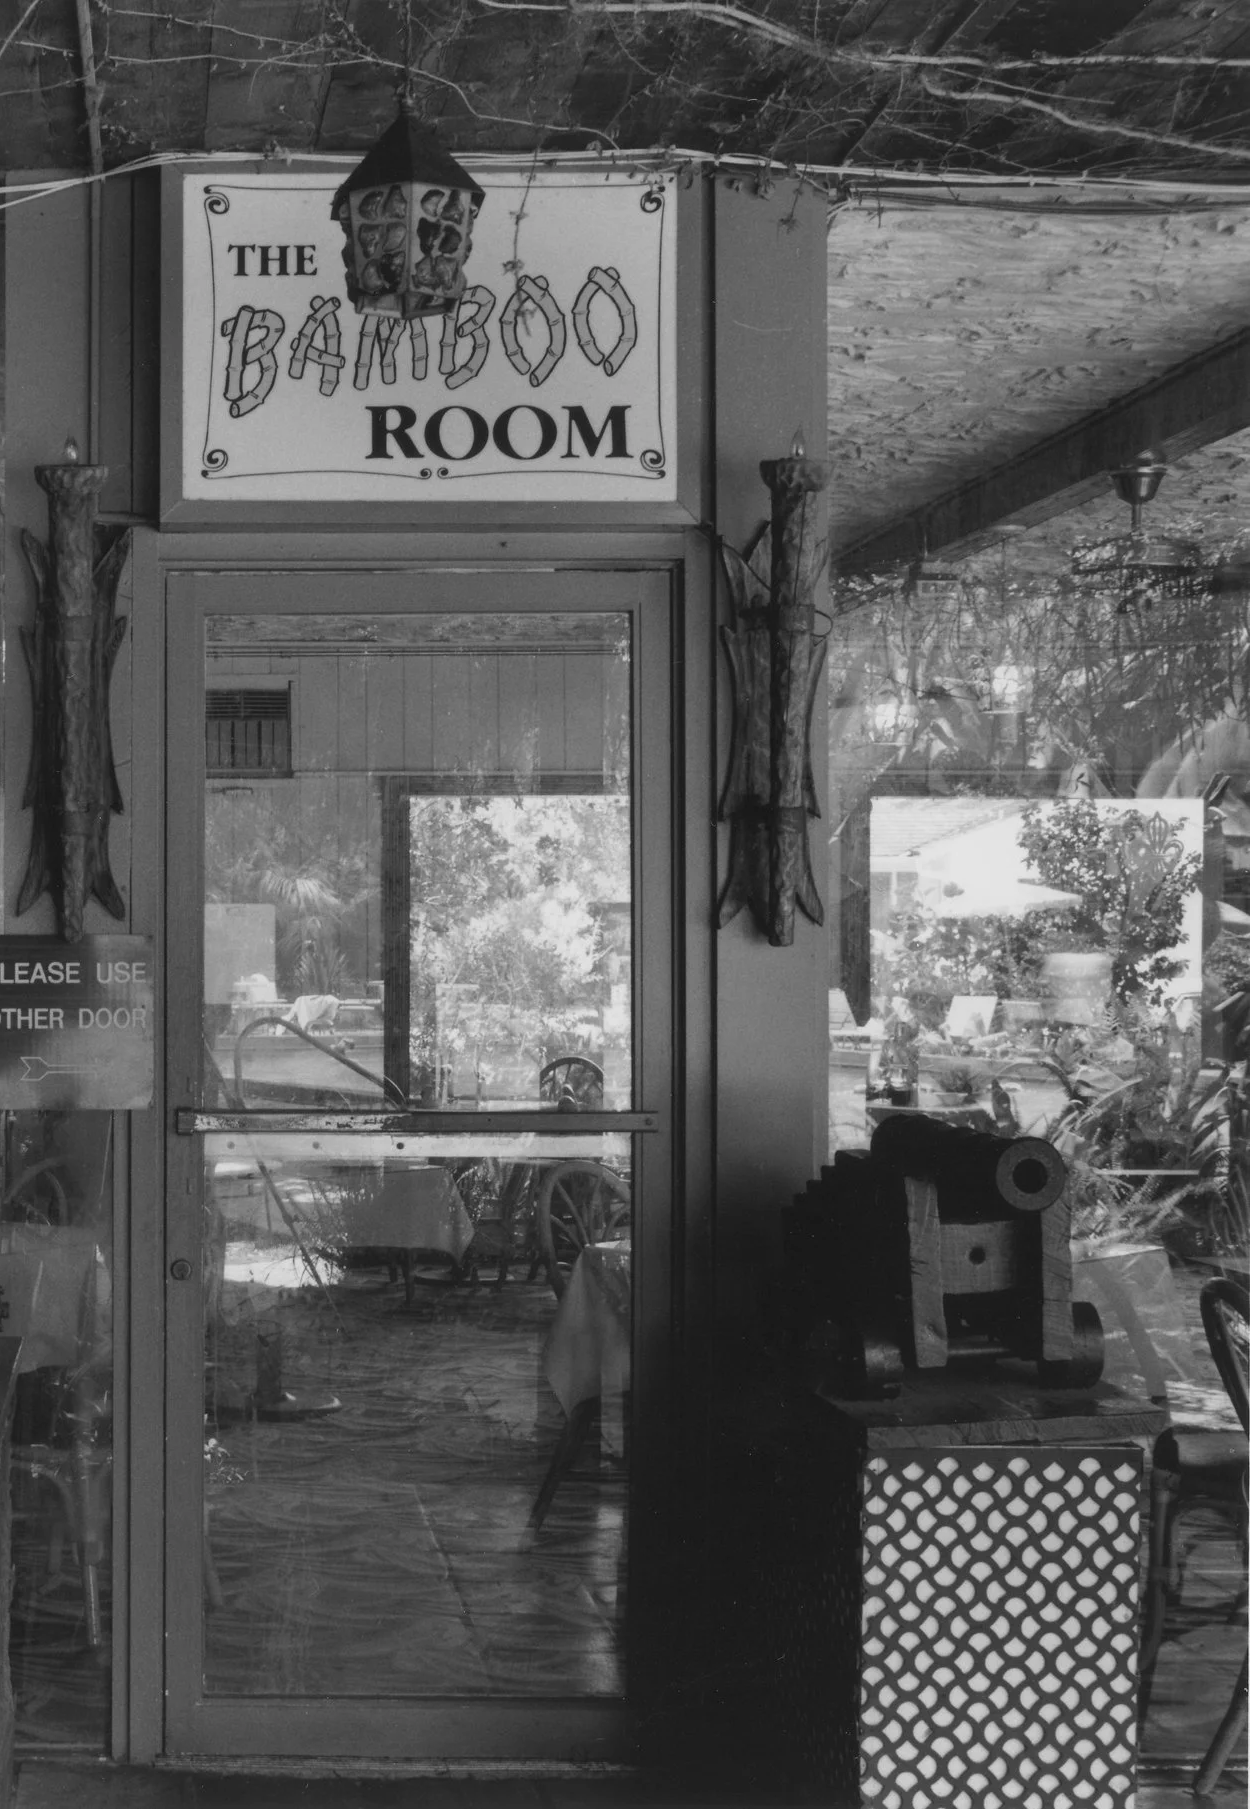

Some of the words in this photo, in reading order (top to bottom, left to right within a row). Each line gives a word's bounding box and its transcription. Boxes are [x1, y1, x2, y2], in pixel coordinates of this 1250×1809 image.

[227, 244, 318, 277] THE
[220, 266, 638, 419] BAMBOO
[364, 405, 635, 460] ROOM
[96, 961, 147, 984] USE
[78, 1007, 147, 1030] DOOR
